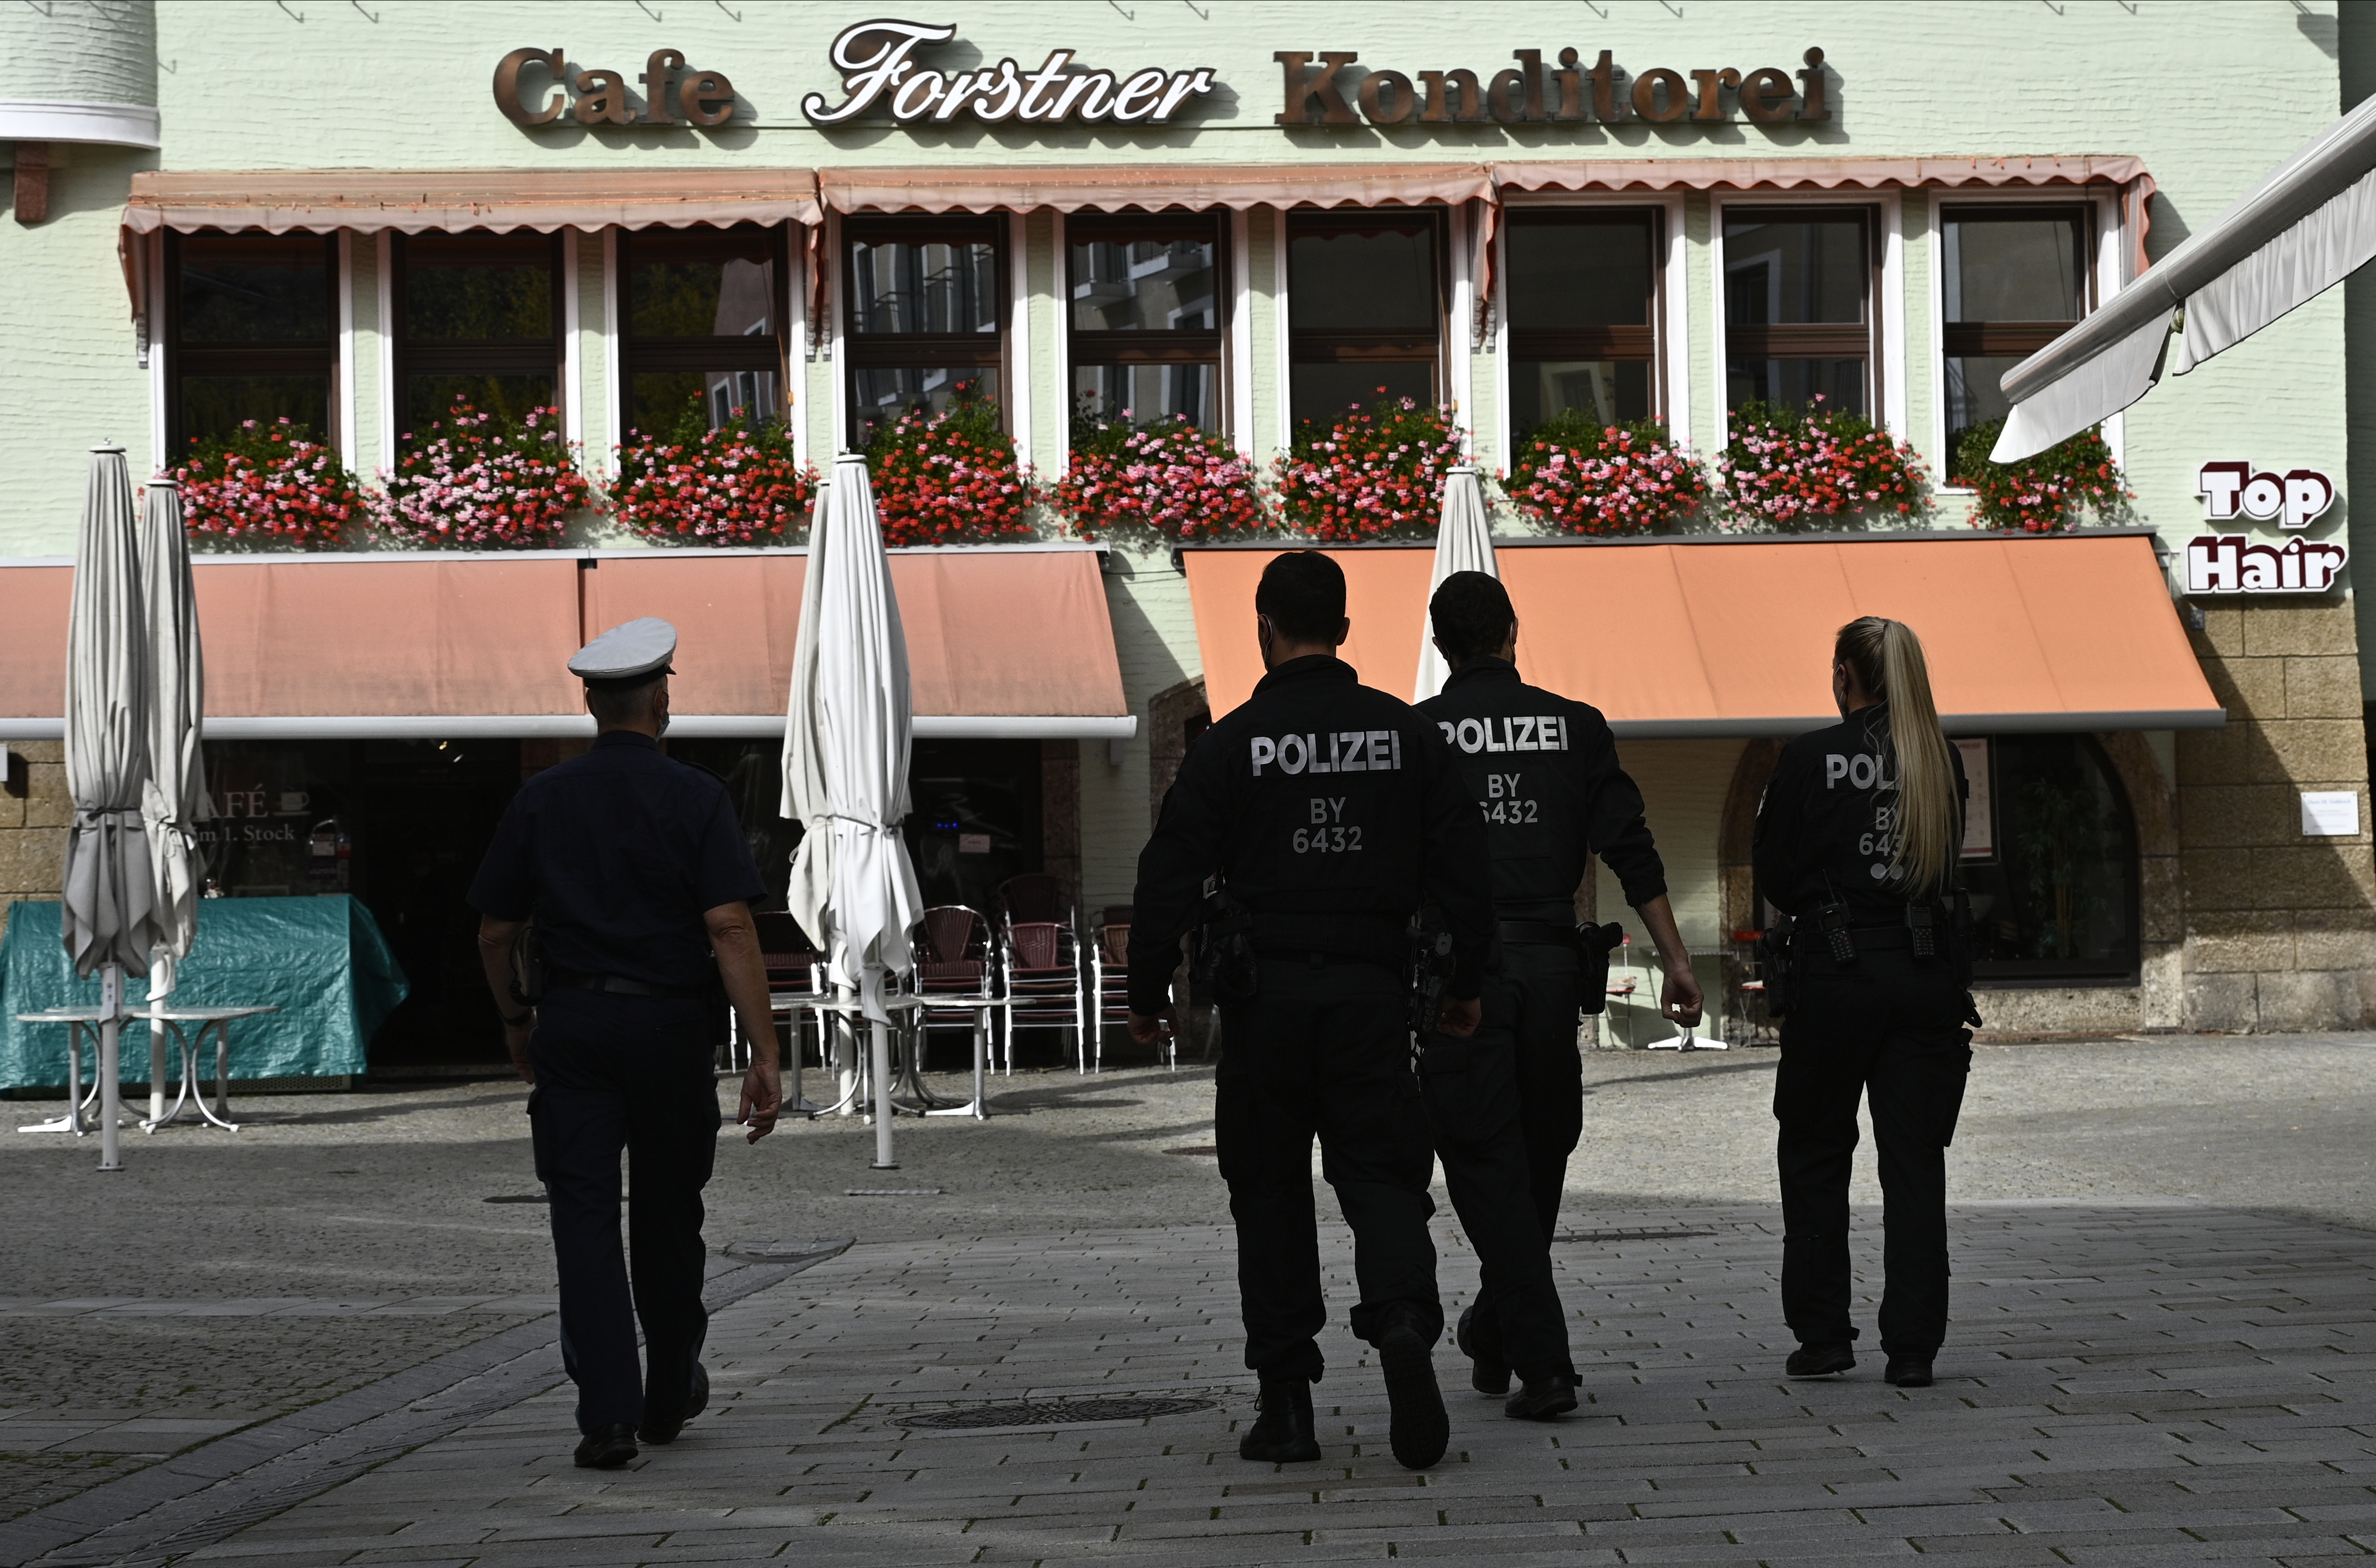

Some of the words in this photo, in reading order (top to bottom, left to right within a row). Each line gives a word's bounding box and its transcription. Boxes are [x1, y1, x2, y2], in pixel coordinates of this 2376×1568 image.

[492, 47, 734, 126] Cafe
[801, 17, 1217, 127] Forstner
[1273, 46, 1832, 125] Konditorei
[2199, 460, 2334, 526] Top
[2187, 535, 2347, 591] Hair
[1250, 730, 1402, 777] POLIZEI
[1825, 753, 1902, 790] POLI
[1487, 773, 1521, 798] BY
[1310, 796, 1347, 824] BY
[224, 827, 238, 842] 1.
[243, 823, 295, 842] Stock
[1292, 825, 1362, 854] 6432
